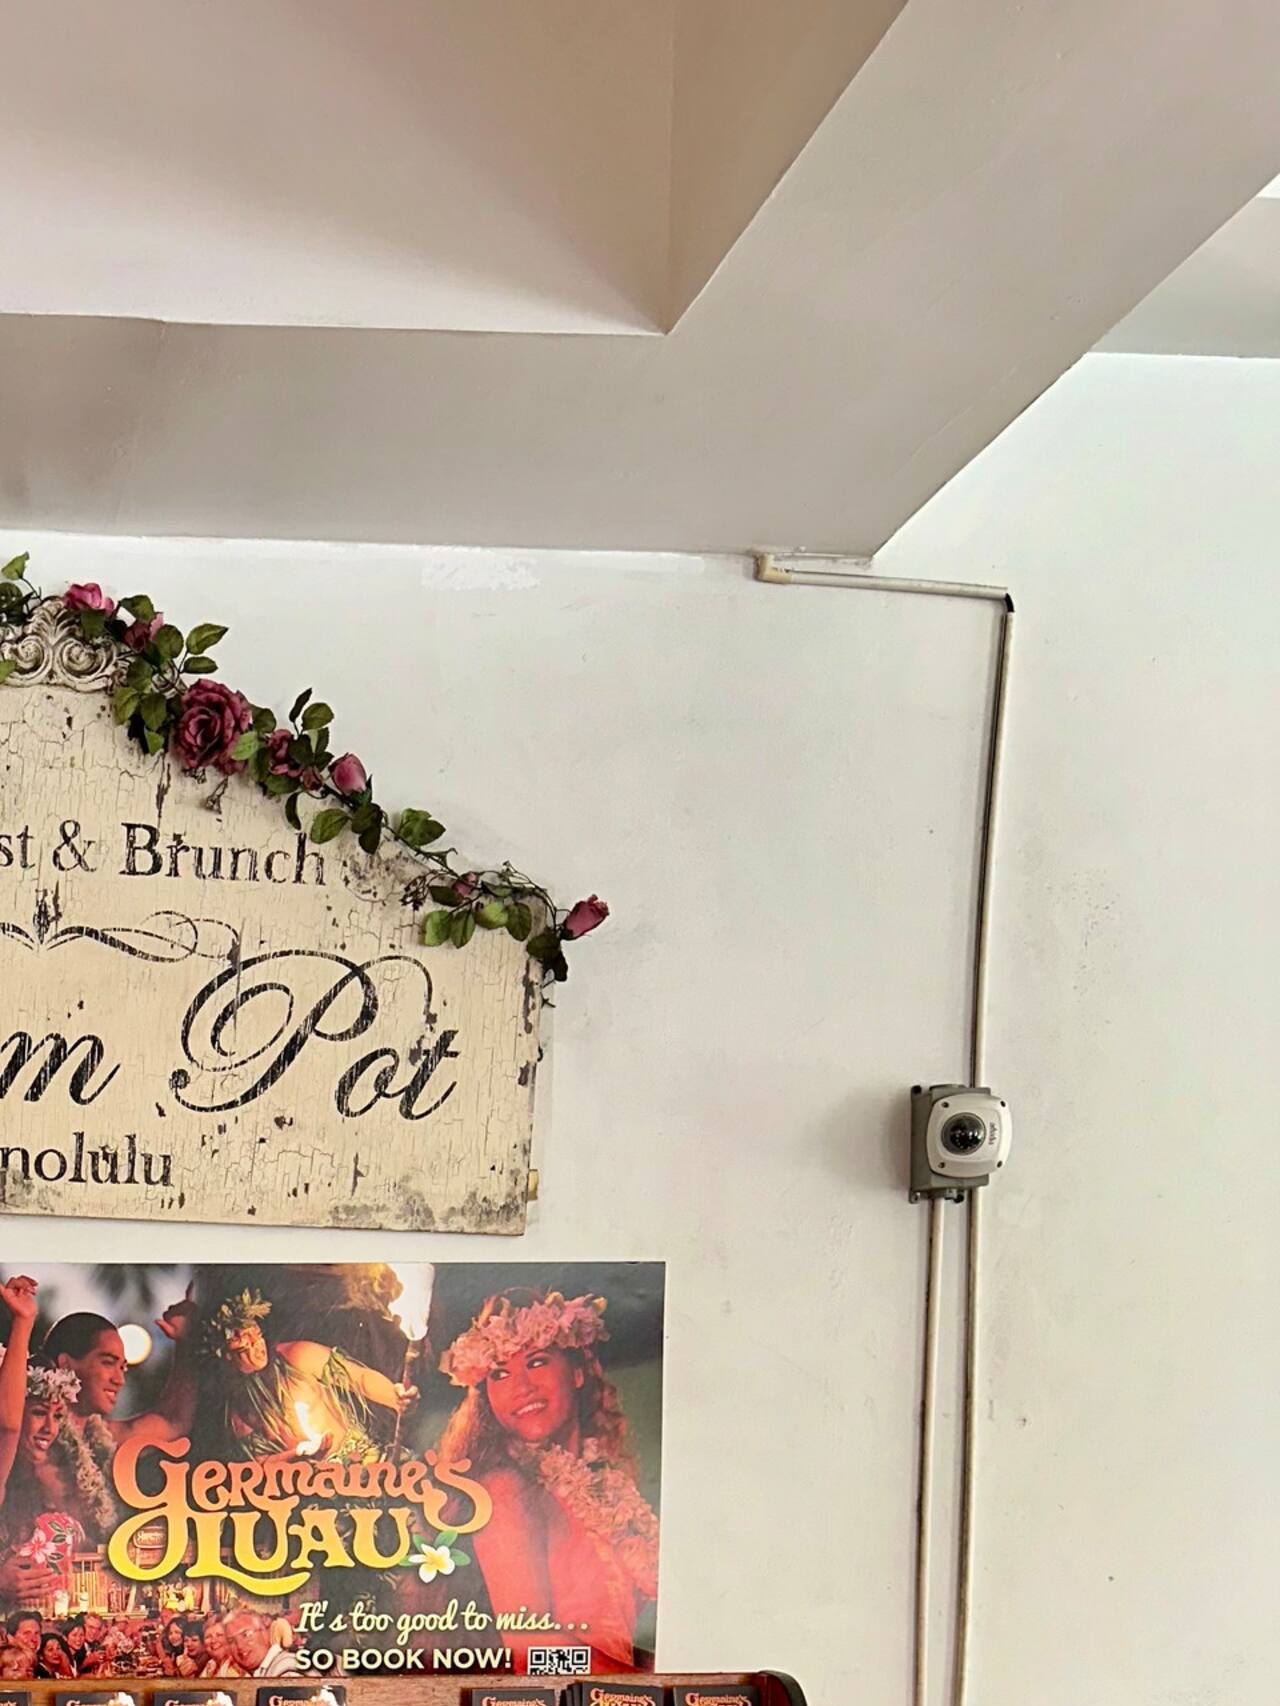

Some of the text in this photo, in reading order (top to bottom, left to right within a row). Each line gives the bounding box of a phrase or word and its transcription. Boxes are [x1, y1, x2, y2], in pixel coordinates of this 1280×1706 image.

[51, 829, 100, 874] &
[121, 819, 327, 887] Brunch
[168, 948, 459, 1123] Pot
[111, 1437, 492, 1534] Germaine's
[108, 1504, 414, 1597] LUAU
[294, 1602, 344, 1634] It's
[350, 1604, 392, 1633] too
[396, 1598, 458, 1652] good
[459, 1601, 493, 1632] to
[295, 1646, 512, 1671] SO BOOK NOW!
